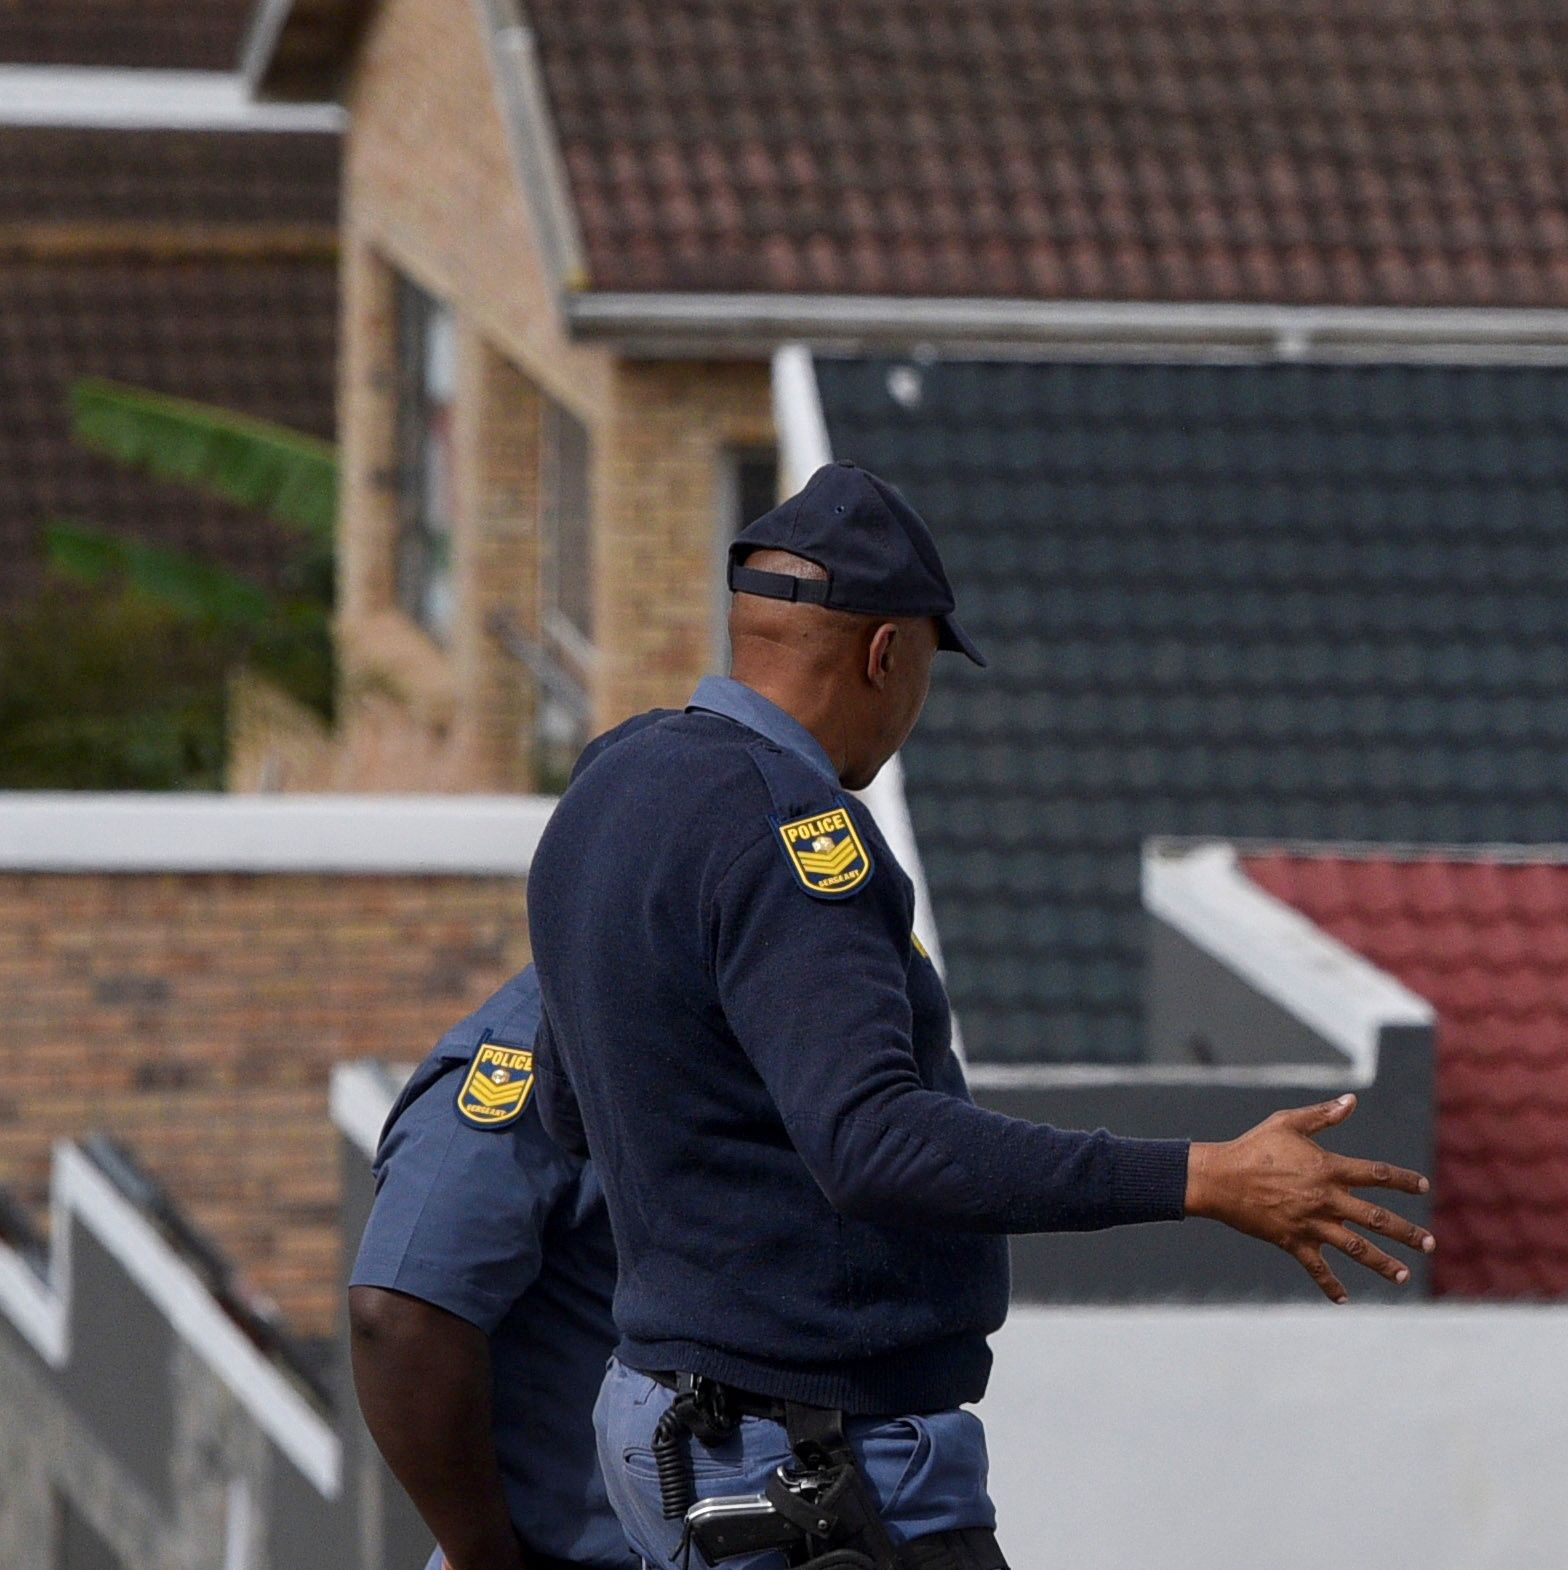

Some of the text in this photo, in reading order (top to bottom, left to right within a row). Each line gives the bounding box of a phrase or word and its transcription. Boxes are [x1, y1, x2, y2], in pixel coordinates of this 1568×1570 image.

[787, 814, 846, 843] POLICE
[818, 869, 860, 888] SERGEANT
[481, 1049, 533, 1072] POLICE
